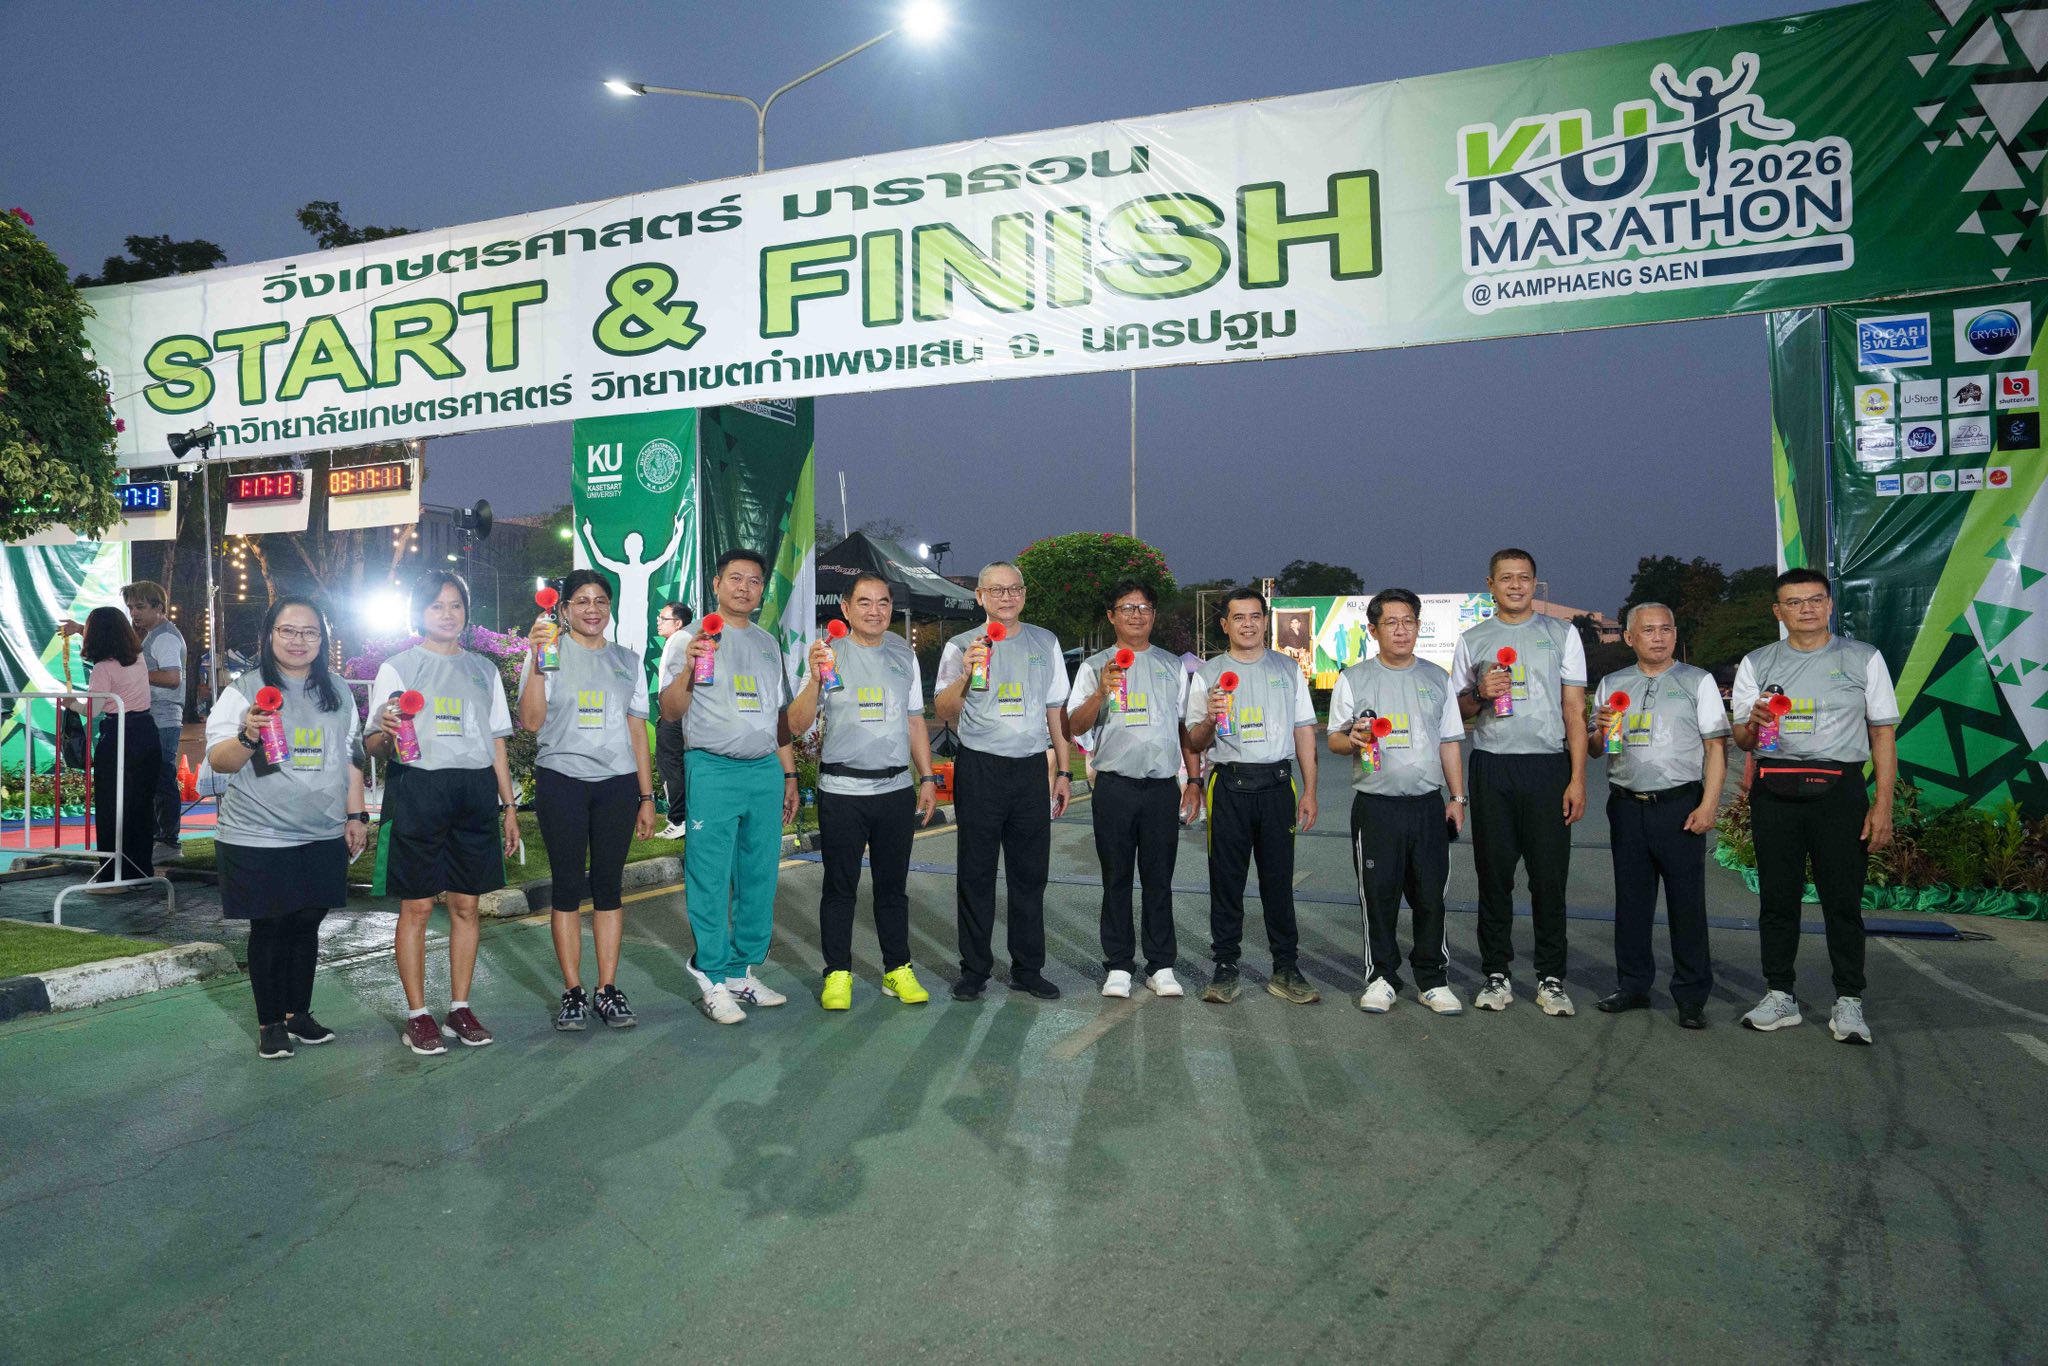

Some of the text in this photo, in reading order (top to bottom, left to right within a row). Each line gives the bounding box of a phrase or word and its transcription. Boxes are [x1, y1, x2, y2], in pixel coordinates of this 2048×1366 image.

[1465, 107, 1649, 217] KU
[1729, 145, 1843, 188] 2026
[262, 145, 1150, 304] วิ่งเกษตรศาสตร์ มาราธอน
[1469, 180, 1843, 267] MARATHON
[143, 169, 1384, 415] START & FINISH
[1471, 260, 1699, 307] @ KAMPHAENG SAEN
[1861, 325, 1926, 341] POCARI
[1970, 326, 2018, 341] CRYSTAL
[1862, 336, 1920, 350] SWEAT
[209, 310, 1297, 447] หาวิทยาลัยเกษตรศาสตร์ วิทยาเขตกำแพงแสน จ. นครปฐม
[587, 442, 623, 474] KU
[239, 475, 293, 497] 1:17:13
[329, 467, 401, 493] 03:17:11
[587, 482, 622, 492] KASETSART
[586, 490, 622, 499] UNIVERSITY
[733, 674, 757, 692] KU
[997, 682, 1021, 698] KU
[577, 690, 604, 708] KU
[857, 687, 882, 702] KU
[434, 696, 462, 715] KU
[1239, 706, 1263, 723] KU
[294, 727, 321, 747] KU
